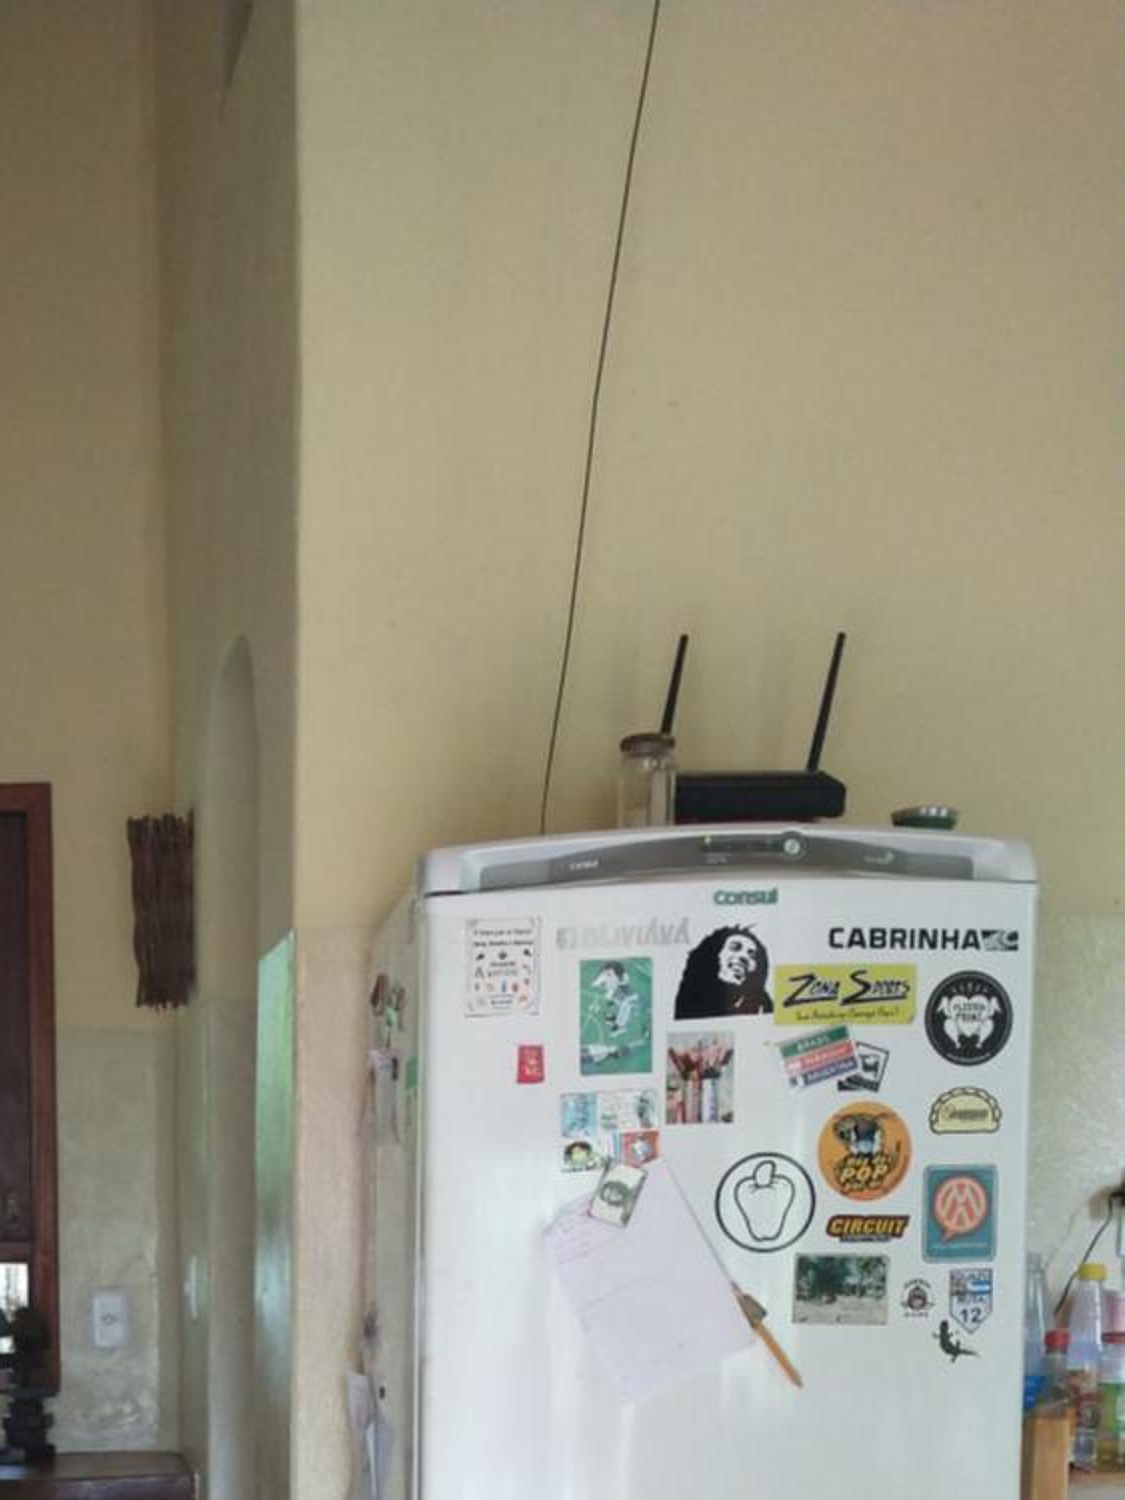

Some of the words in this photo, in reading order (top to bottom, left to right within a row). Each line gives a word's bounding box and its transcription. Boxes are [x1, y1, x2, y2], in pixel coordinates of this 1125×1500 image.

[828, 926, 981, 951] CABRINHA
[840, 1165, 888, 1183] POP
[827, 1217, 906, 1235] CIRCUIT
[959, 1307, 982, 1324] 12
